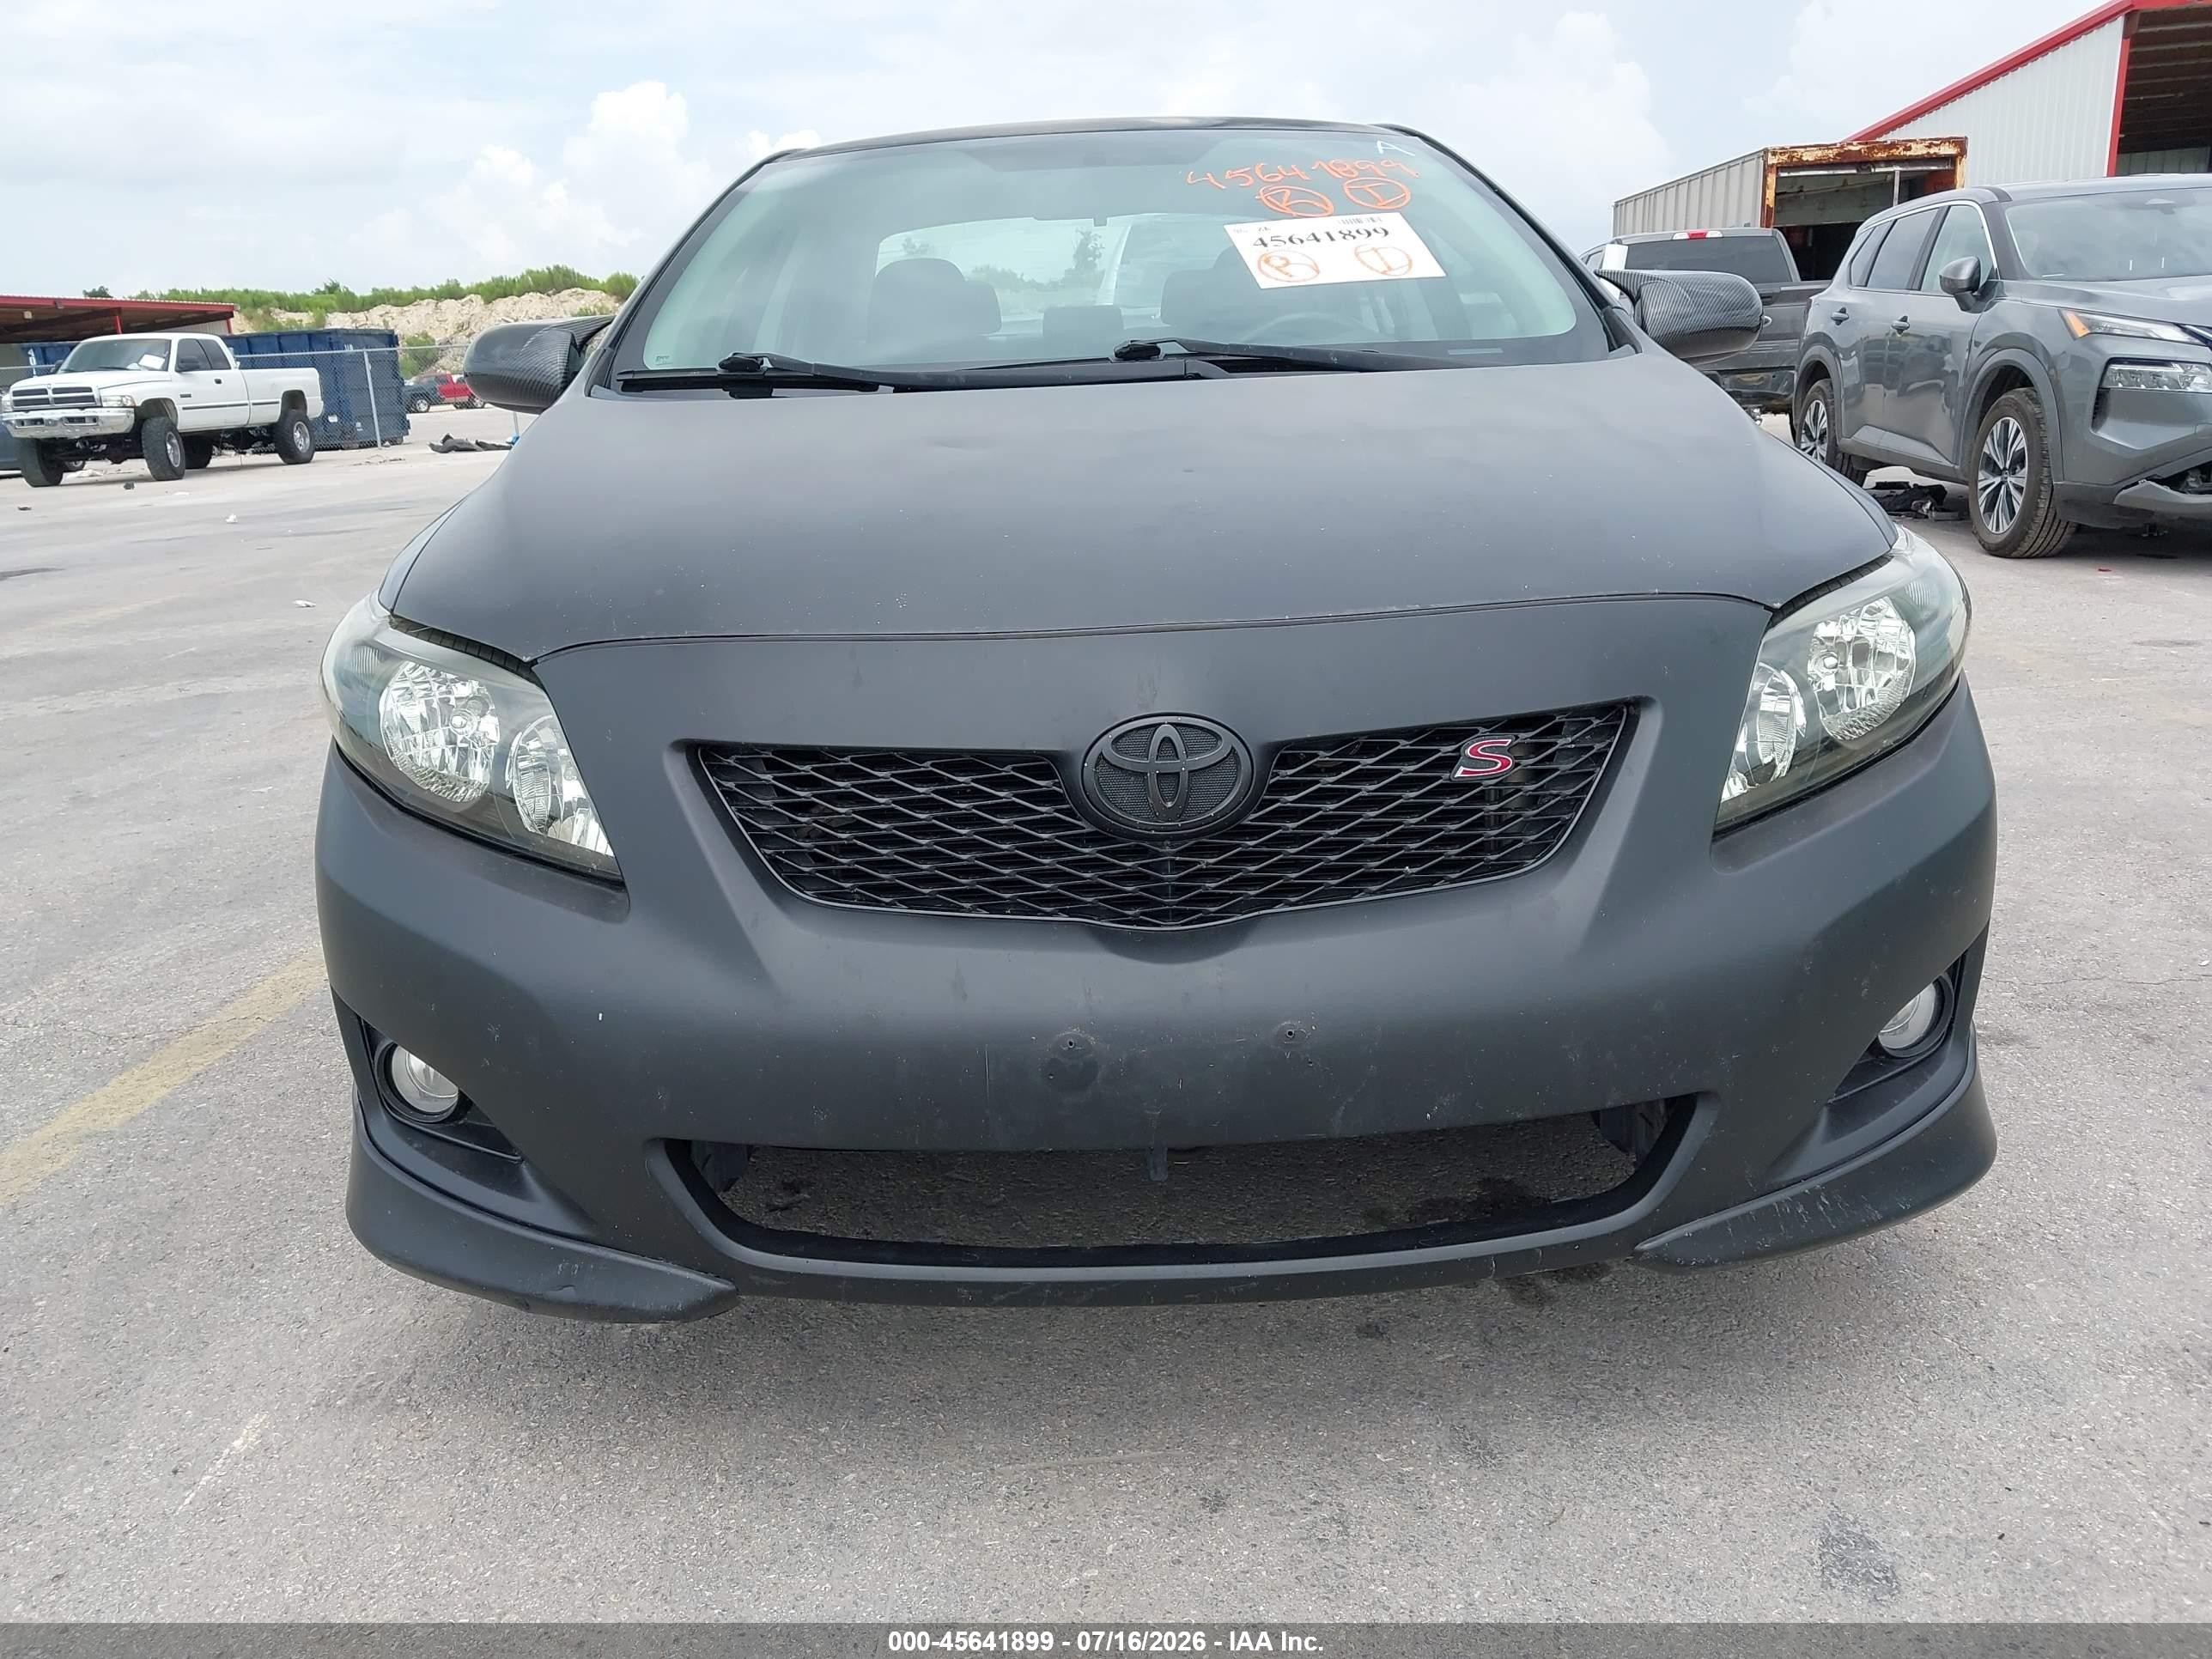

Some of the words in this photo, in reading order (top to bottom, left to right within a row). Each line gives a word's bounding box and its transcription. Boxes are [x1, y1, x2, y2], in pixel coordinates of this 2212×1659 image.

[1376, 140, 1416, 157] A
[1187, 159, 1421, 190] 45641899
[1253, 227, 1389, 248] 45641899
[1454, 738, 1514, 779] S
